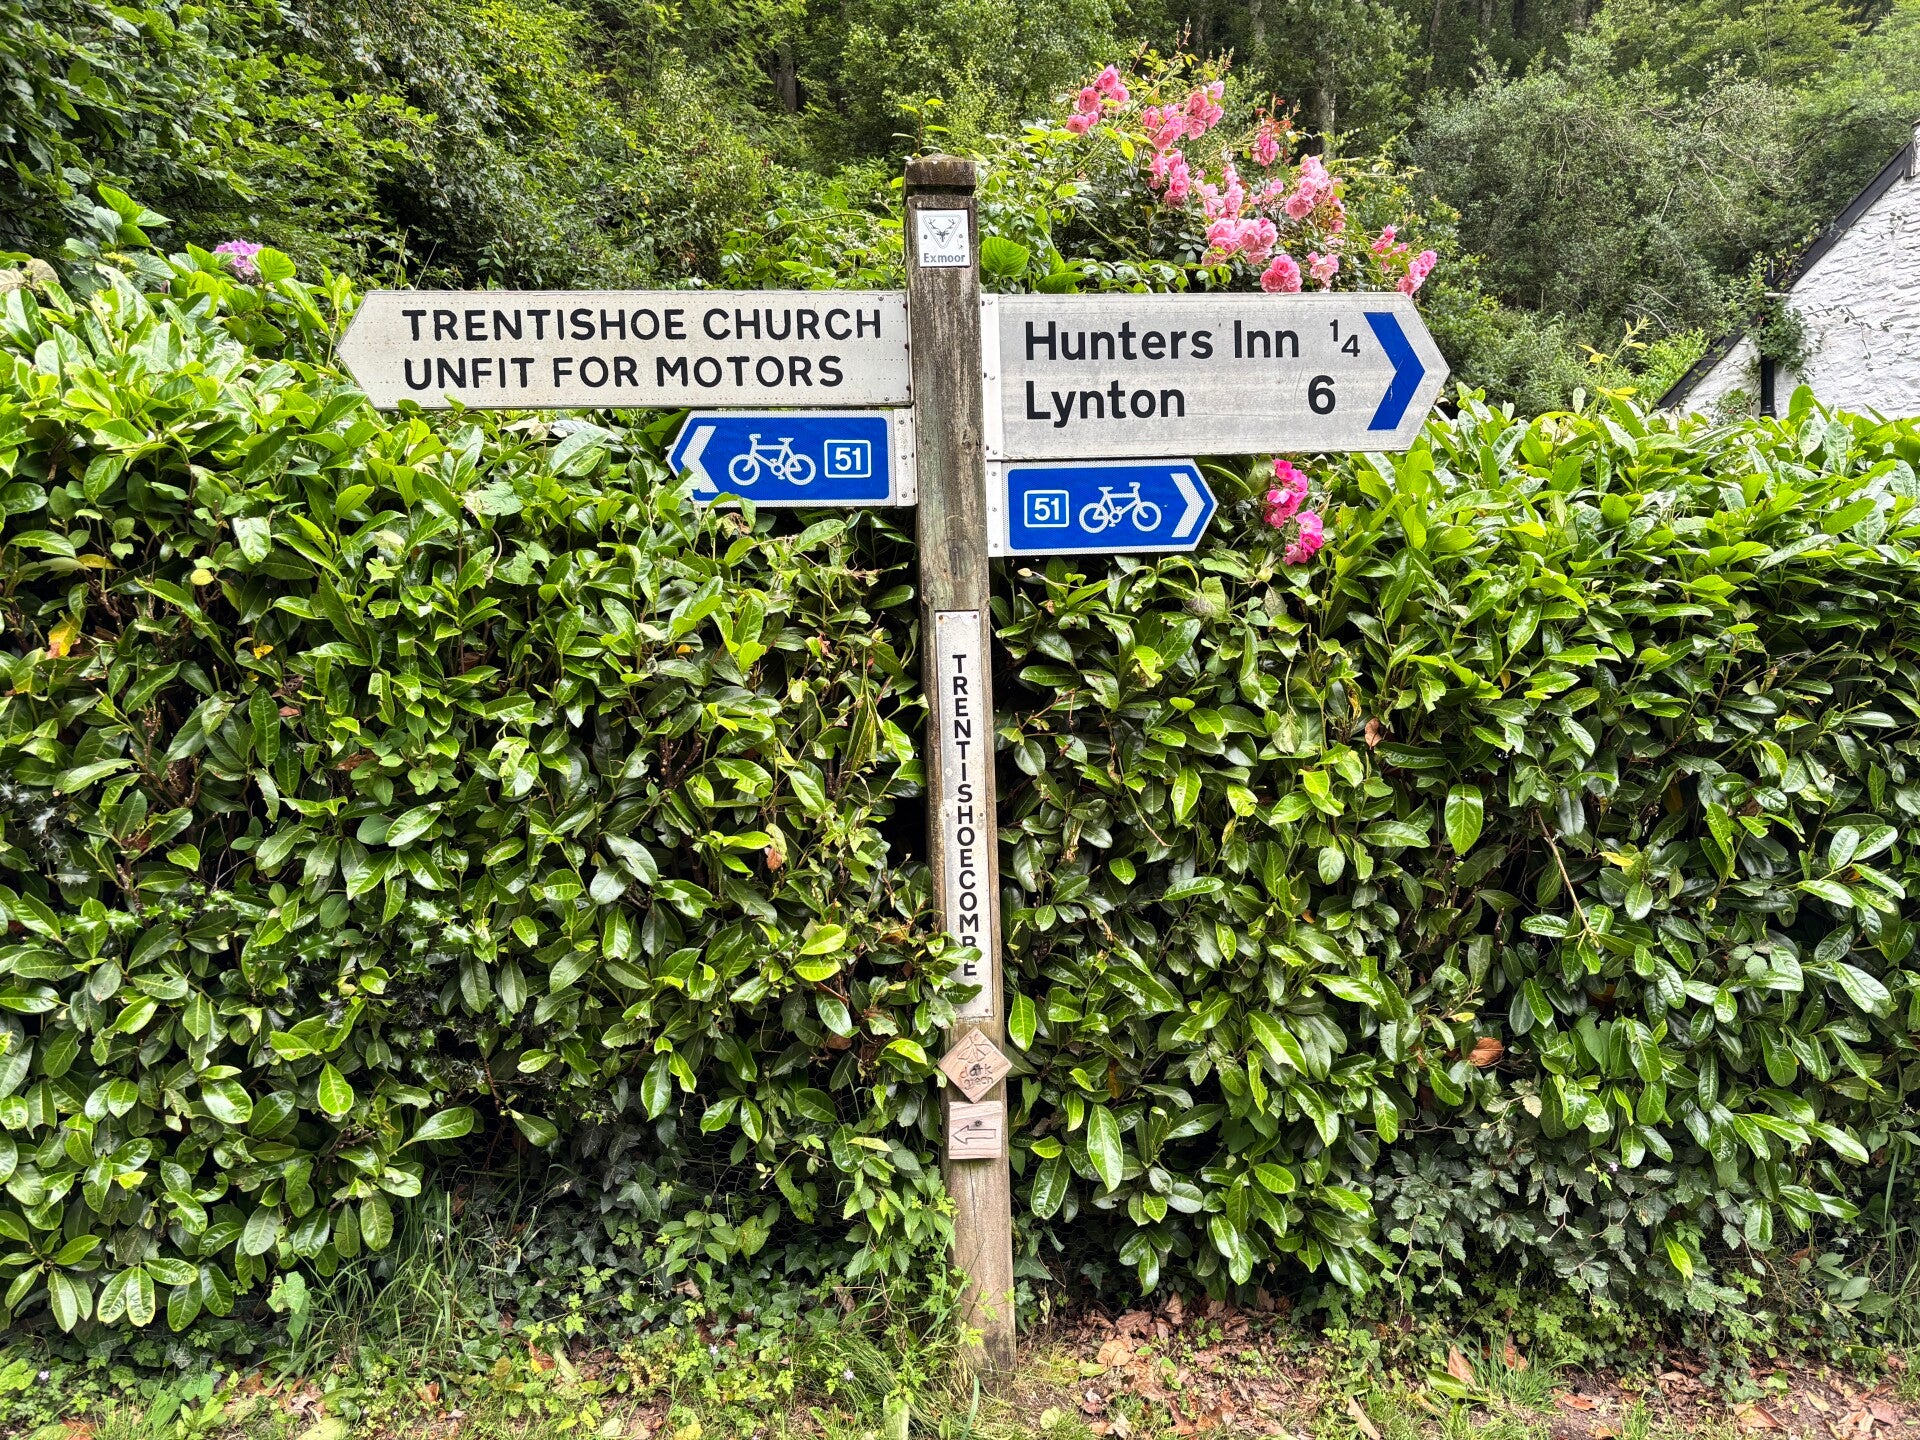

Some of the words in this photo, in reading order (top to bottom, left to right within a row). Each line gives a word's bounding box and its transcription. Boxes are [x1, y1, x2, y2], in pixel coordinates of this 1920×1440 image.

[923, 252, 966, 263] Exmoor
[402, 309, 687, 341] TRENTISHOE
[702, 308, 880, 340] CHURCH
[1026, 320, 1213, 360] Hunters
[1234, 320, 1299, 358] Inn
[405, 358, 534, 390] UNFIT
[553, 356, 638, 388] FOR
[656, 356, 843, 387] MOTORS
[1026, 380, 1184, 428] Lynton
[1308, 375, 1335, 414] 6
[835, 447, 861, 472] 51
[1034, 497, 1060, 521] 51
